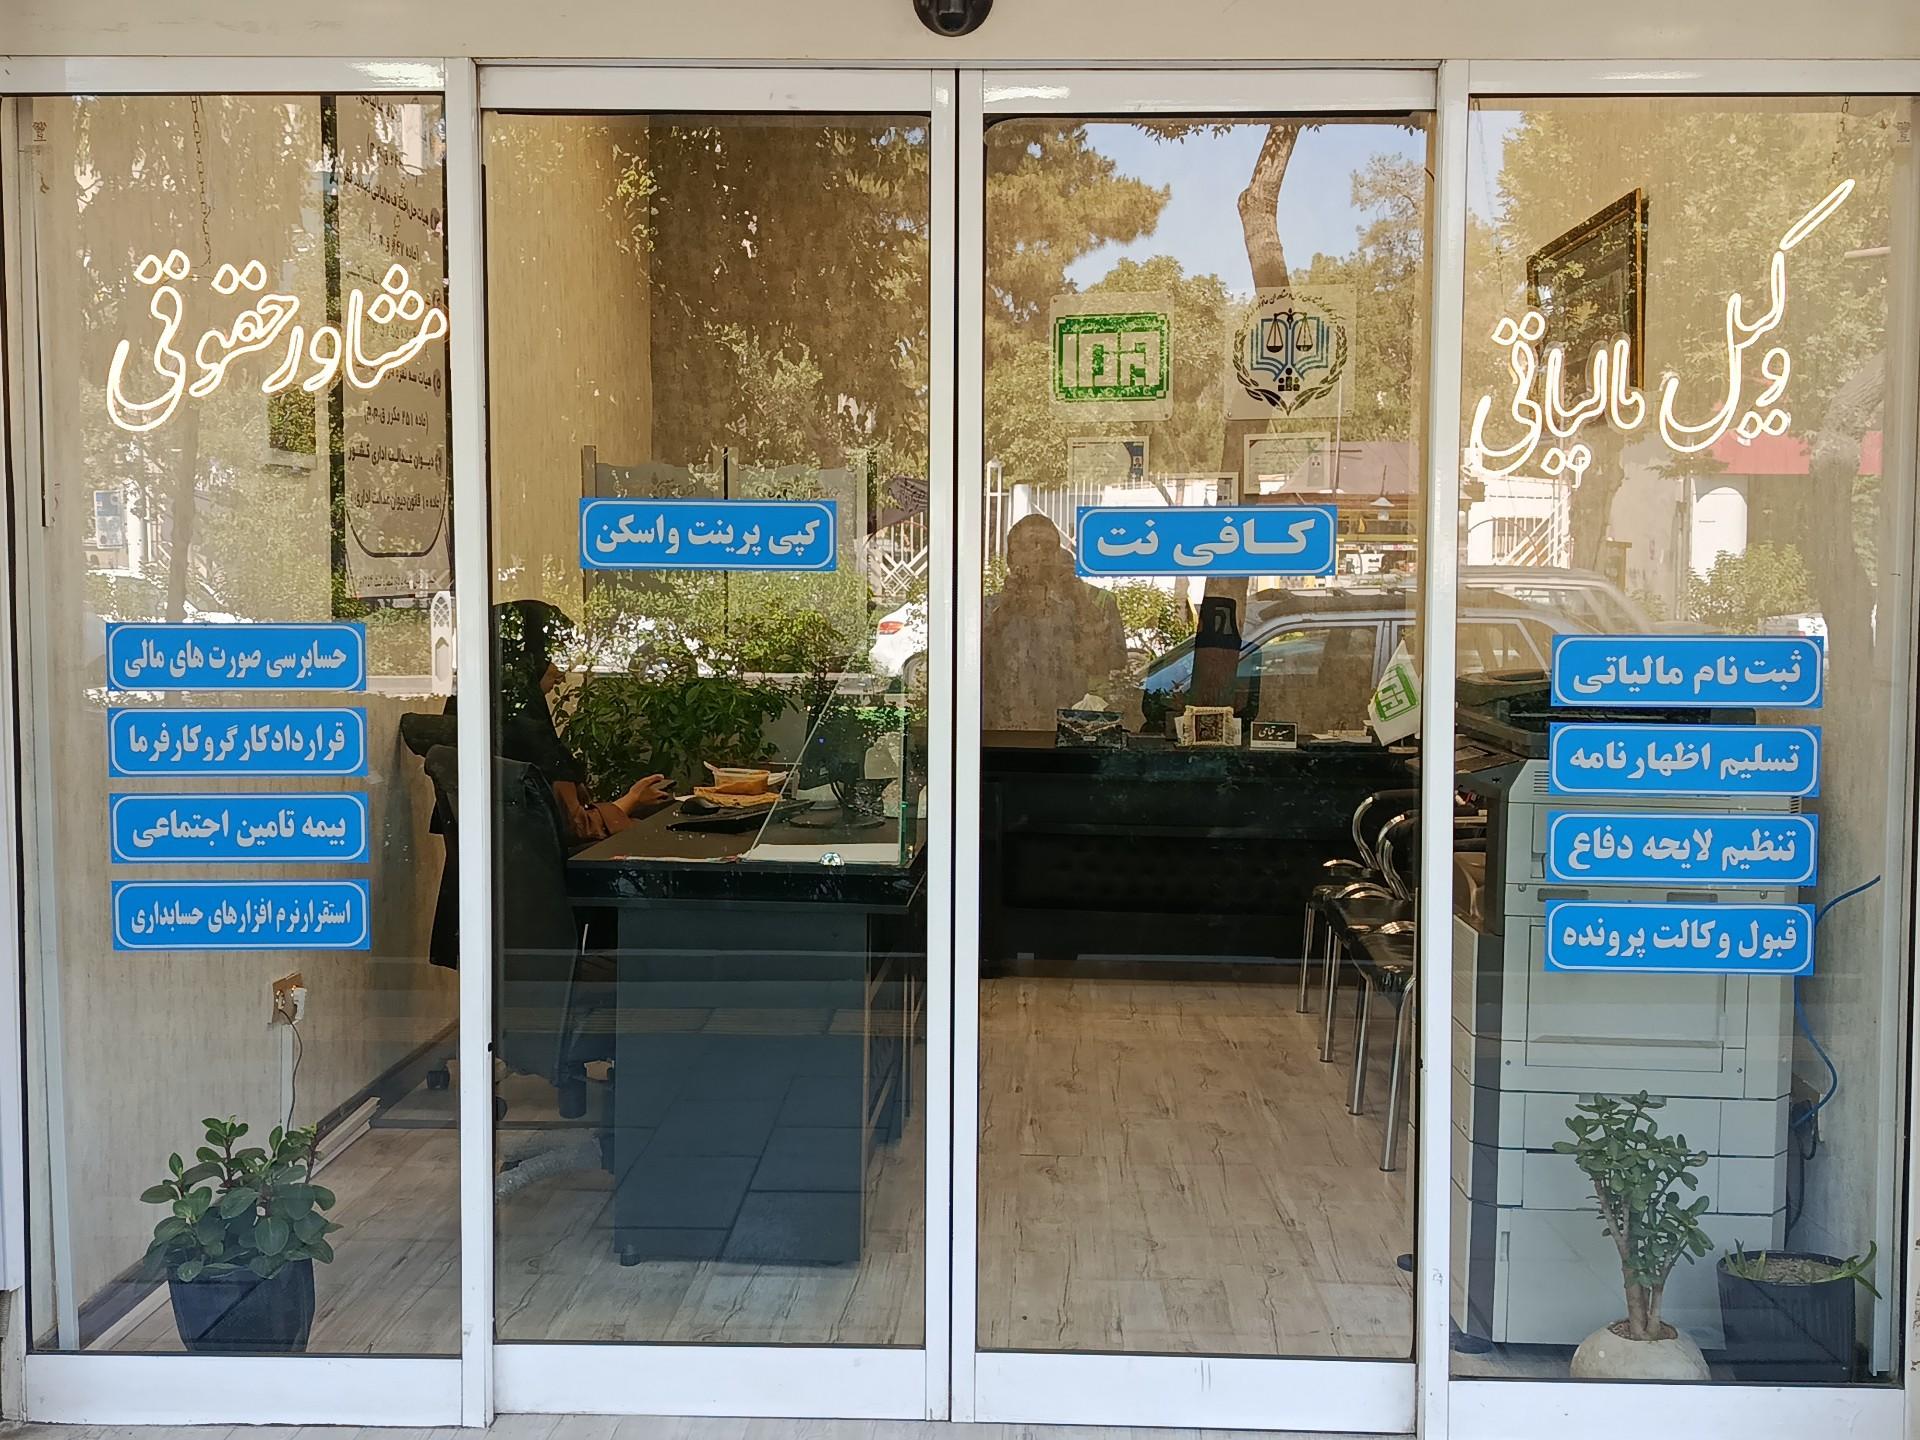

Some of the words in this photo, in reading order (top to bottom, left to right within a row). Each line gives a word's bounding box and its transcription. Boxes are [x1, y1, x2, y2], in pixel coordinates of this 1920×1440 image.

[262, 263, 449, 394] مشاور
[1659, 178, 1856, 453] وکیل
[106, 248, 301, 433] حقوقی
[1469, 311, 1646, 478] مالیاتی
[688, 519, 761, 556] پرینت
[769, 520, 820, 556] کپی
[1096, 519, 1159, 557] نت
[1173, 516, 1316, 567] کافی
[124, 639, 165, 678] مالی
[169, 639, 204, 678] های
[208, 647, 262, 679] صورت
[266, 640, 347, 679] حسابرسی
[1573, 655, 1684, 694] مالیاتی
[1694, 656, 1738, 694] نام
[1744, 649, 1802, 691] ثبت
[271, 722, 345, 762] قرارداد
[1720, 743, 1800, 780] تسلیم
[132, 809, 229, 848] اجتماعی
[236, 810, 295, 847] تامین
[303, 816, 346, 846] بیمه
[1568, 825, 1634, 870] دفاع
[1642, 828, 1713, 869] لایحه
[1721, 828, 1796, 871] تنظیم
[131, 901, 204, 934] حسابداری
[1563, 918, 1646, 958] پرونده
[1653, 919, 1731, 959] وکالت
[1738, 918, 1797, 959] قبول
